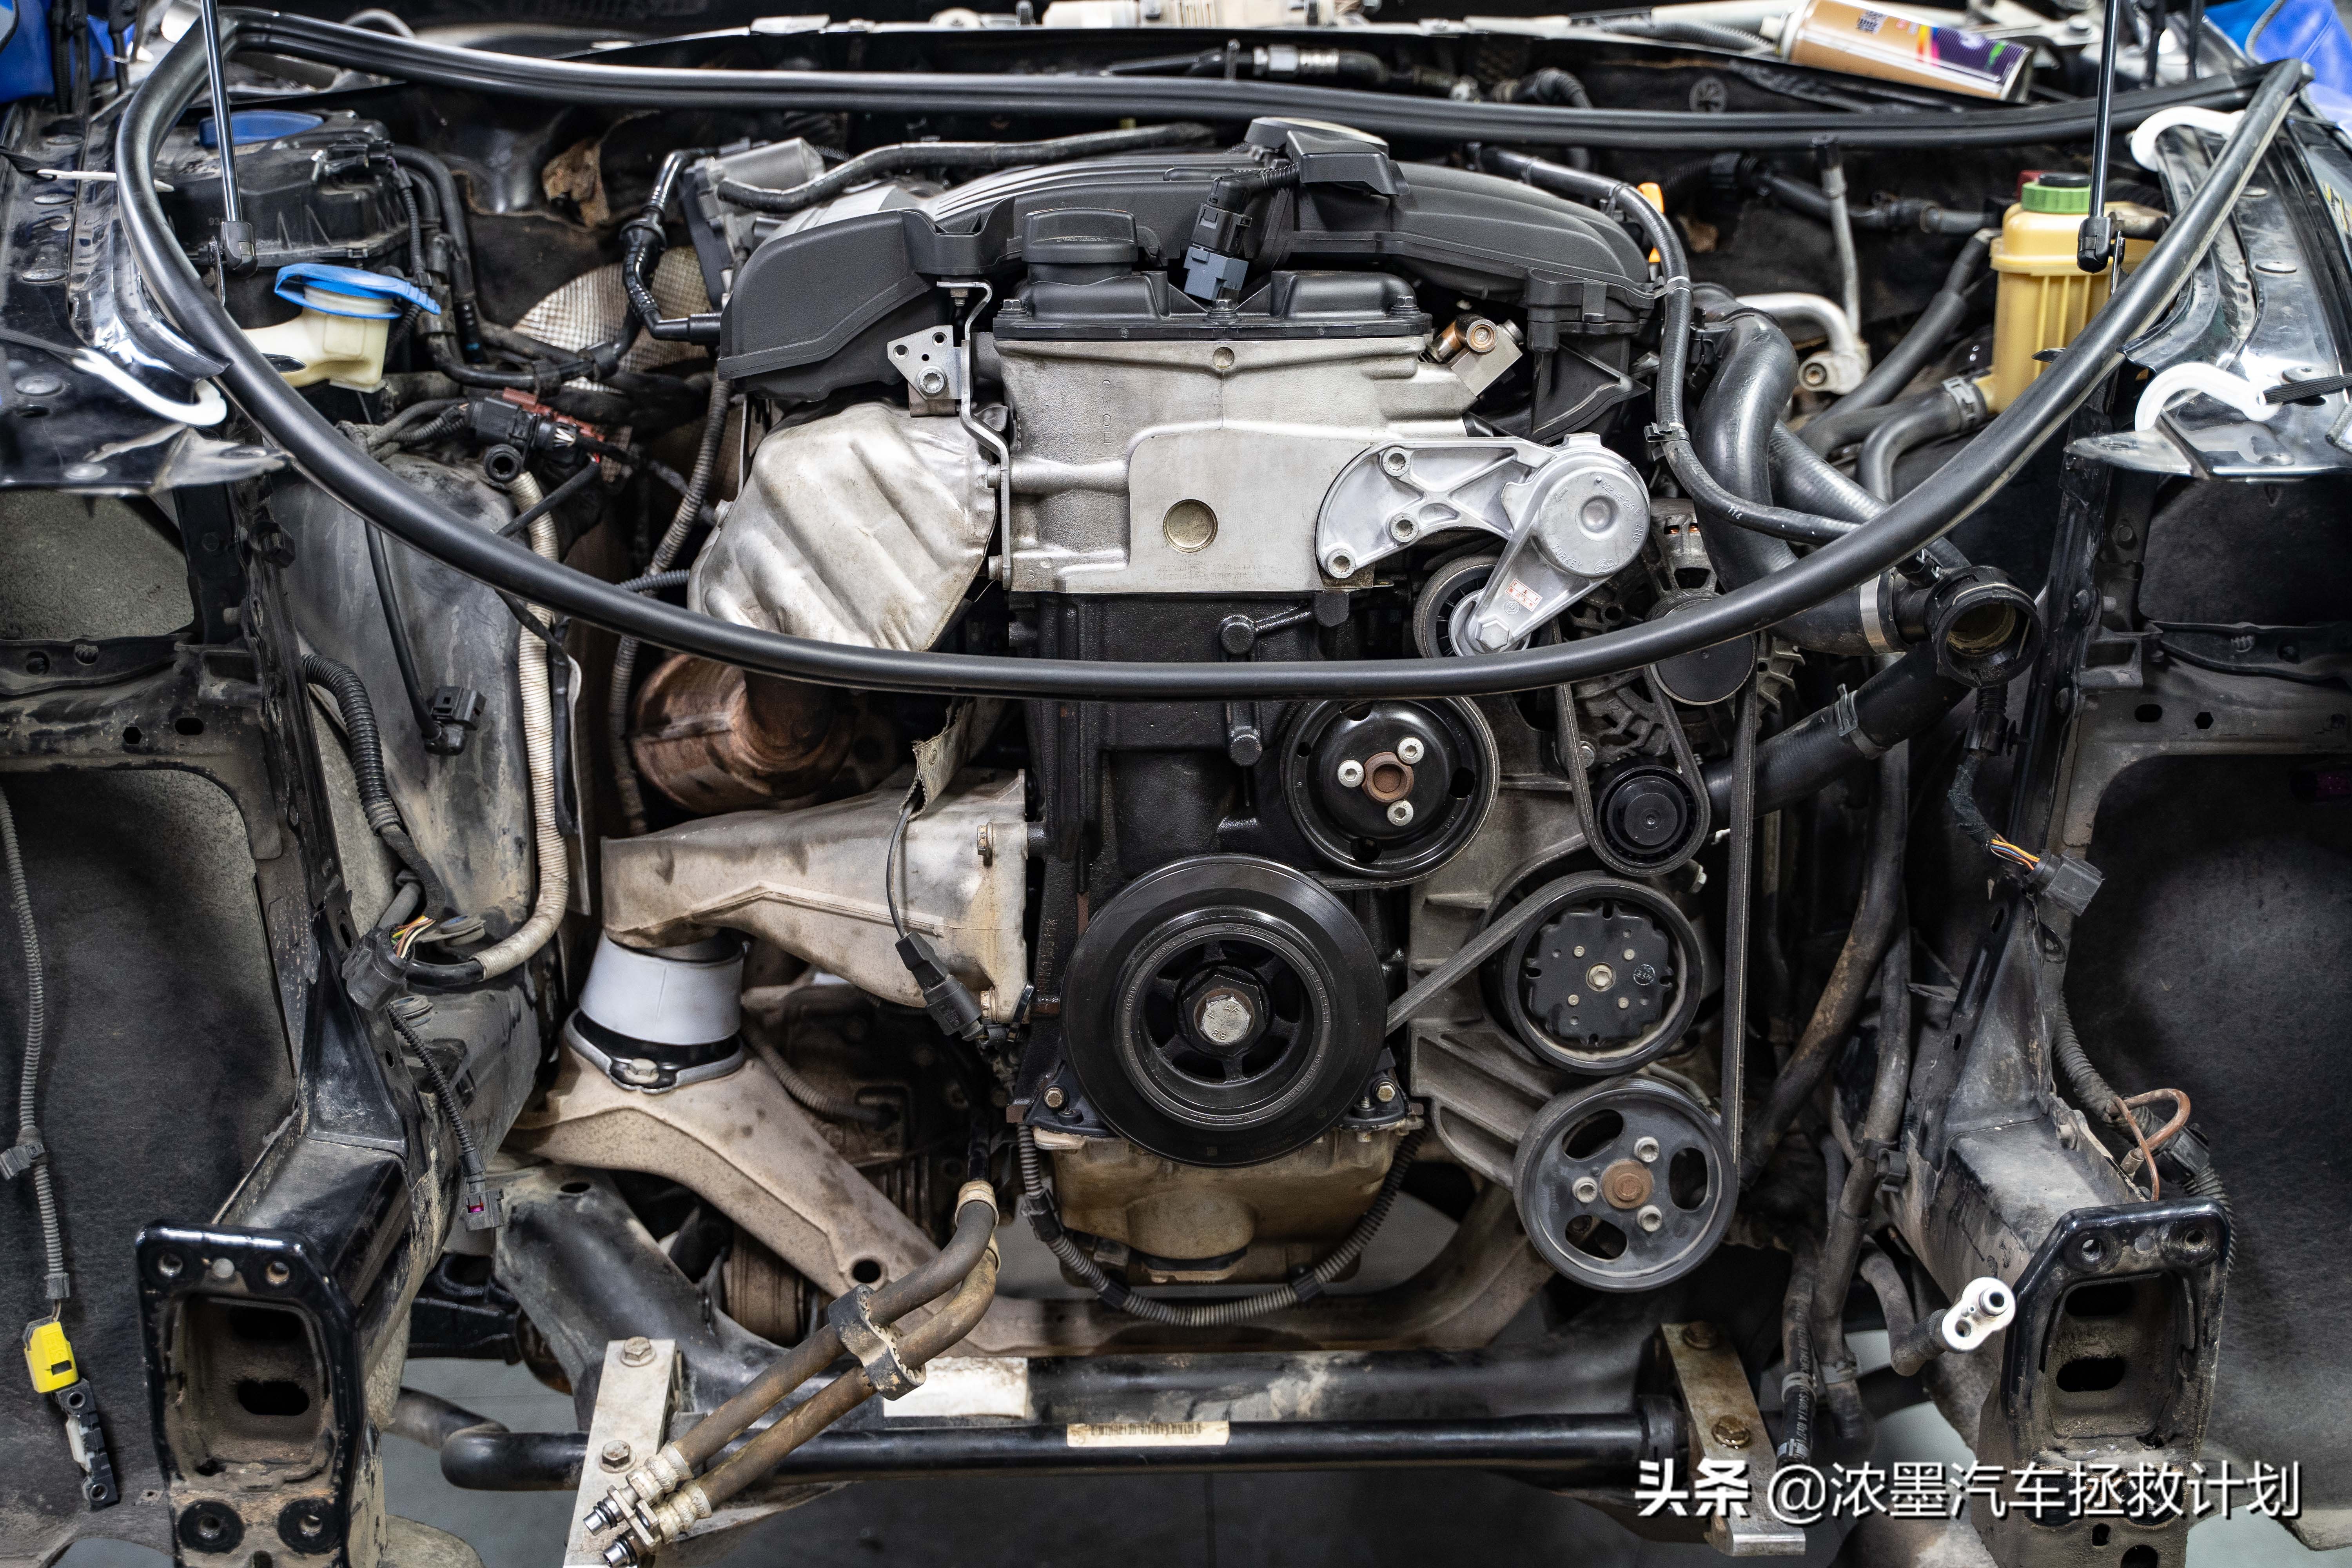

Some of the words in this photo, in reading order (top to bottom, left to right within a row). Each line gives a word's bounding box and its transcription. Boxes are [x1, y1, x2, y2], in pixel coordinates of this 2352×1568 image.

[1602, 482, 1613, 494] 022
[1613, 491, 1624, 502] 145
[1623, 499, 1635, 511] 299
[1552, 543, 1582, 570] TURKEY
[1028, 569, 1035, 581] 3
